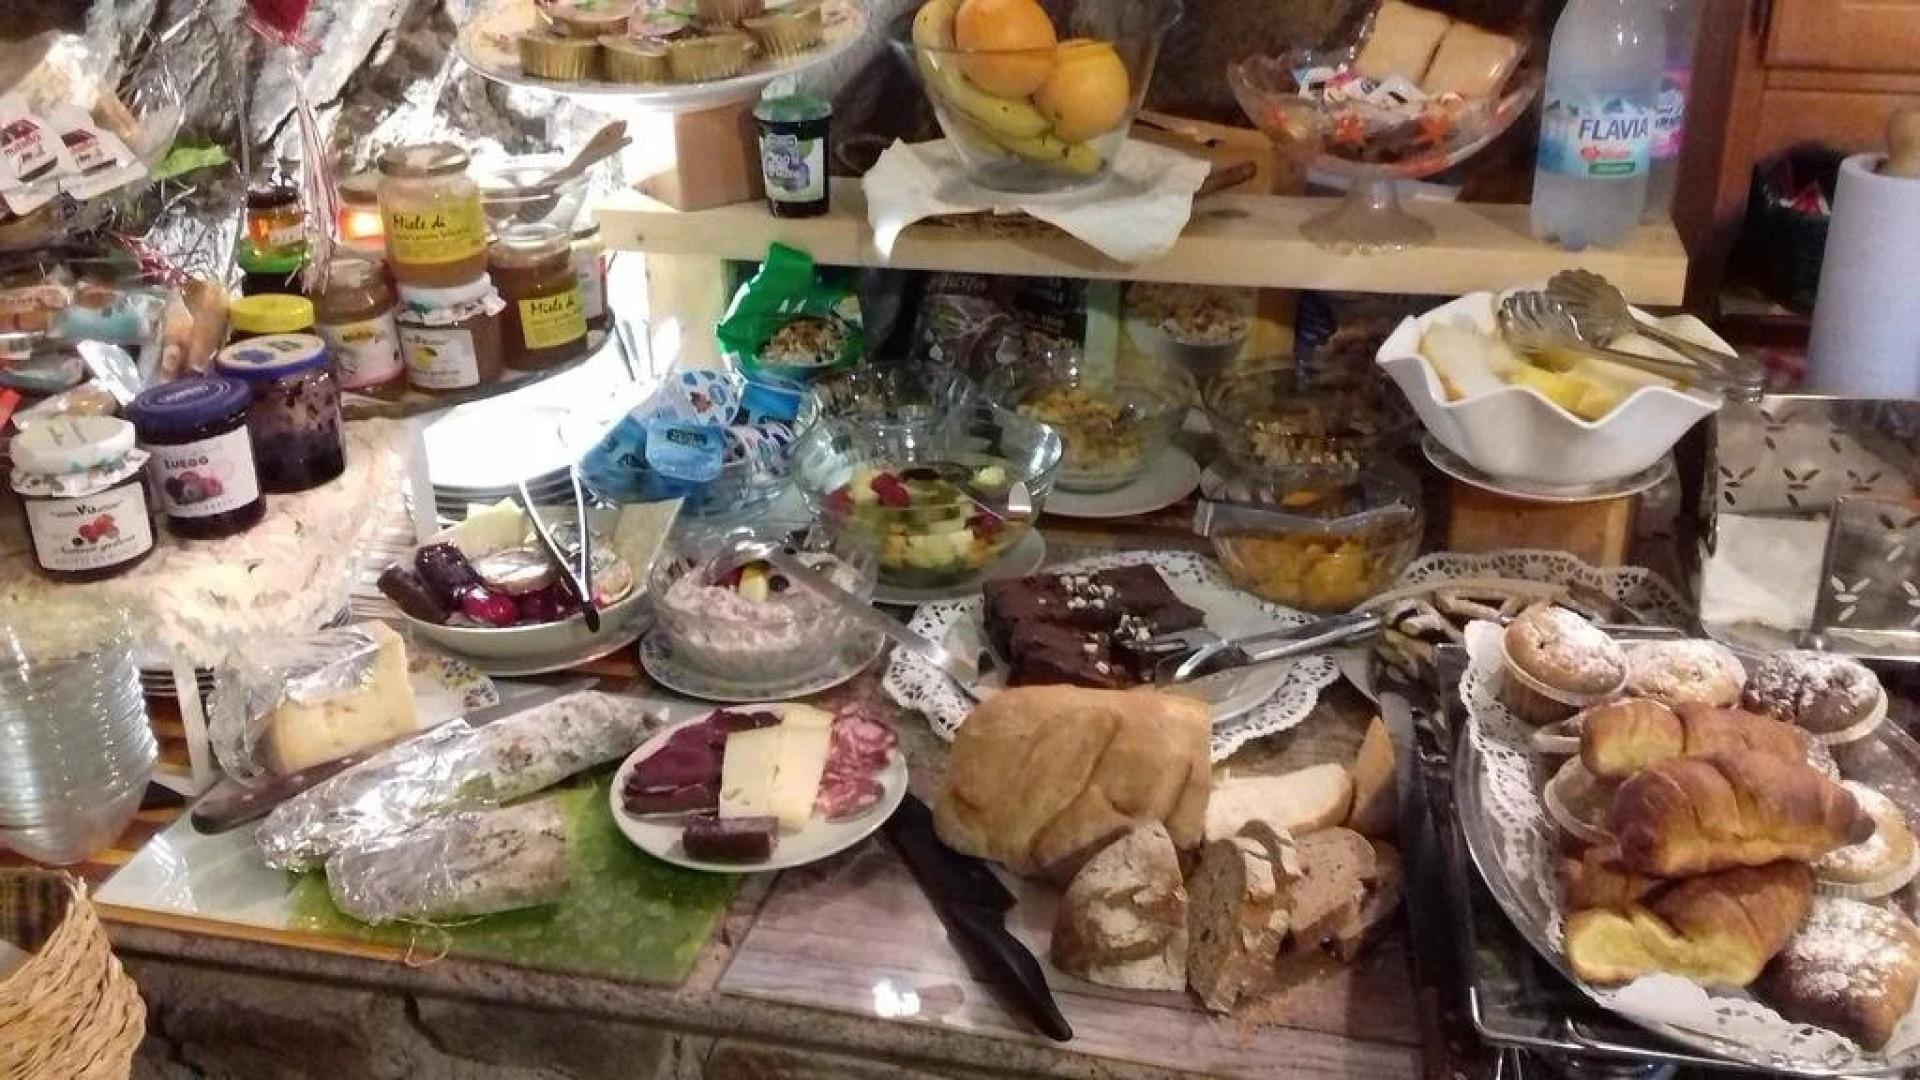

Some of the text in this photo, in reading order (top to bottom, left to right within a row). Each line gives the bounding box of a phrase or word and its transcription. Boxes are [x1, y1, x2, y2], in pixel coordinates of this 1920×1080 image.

[1578, 119, 1648, 140] FLAVIA
[392, 213, 446, 230] Miele di
[530, 298, 564, 315] Miele
